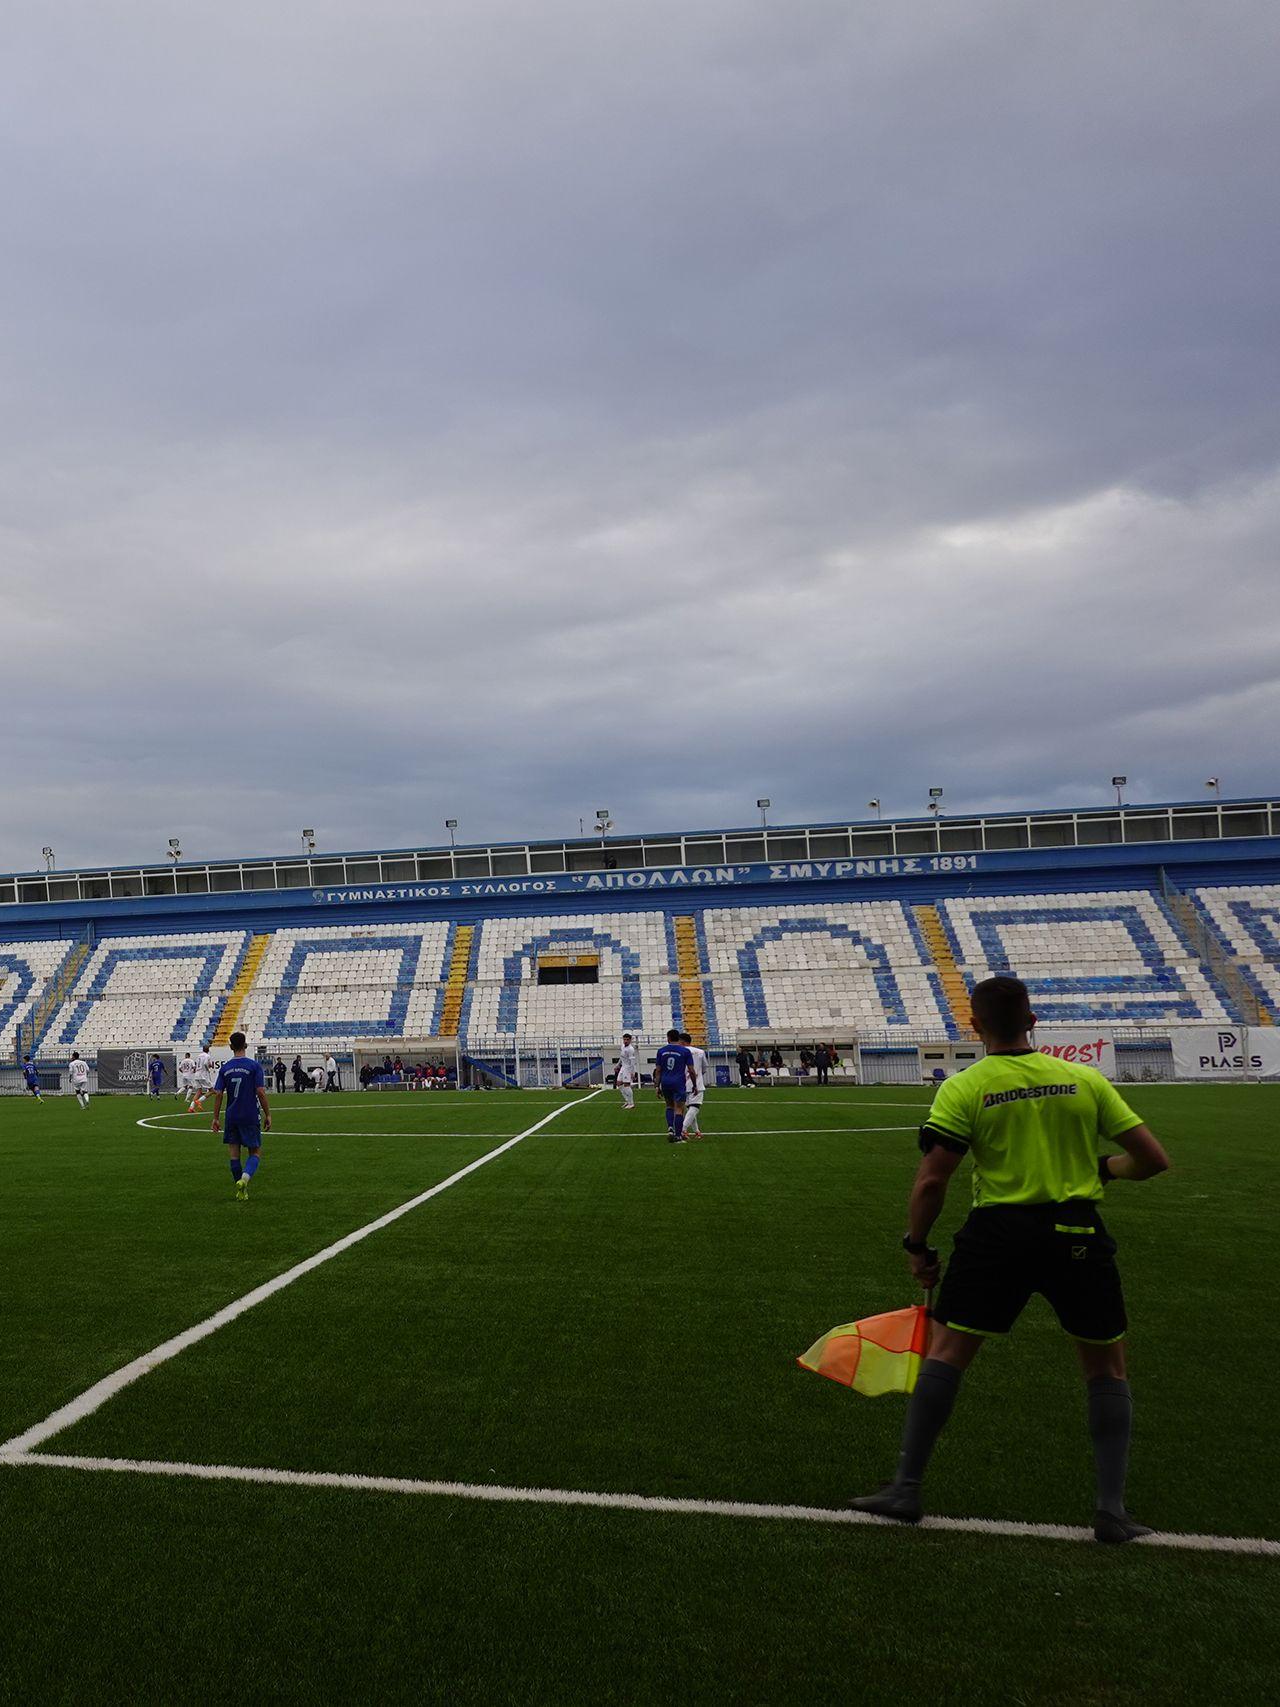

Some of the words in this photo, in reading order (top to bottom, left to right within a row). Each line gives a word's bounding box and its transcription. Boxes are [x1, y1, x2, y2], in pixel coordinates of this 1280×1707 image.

[327, 886, 450, 902] ΓΥΜΝΑΣΤΙΚΟΣ
[461, 881, 556, 895] ΣΥΛΛΟΓΟΣ
[769, 858, 921, 879] ΣΜΥΡΝΗΣ
[930, 855, 977, 871] 1891
[666, 1057, 675, 1071] 9
[1199, 1055, 1263, 1068] PLASS
[231, 1077, 242, 1098] 7
[983, 1083, 1077, 1108] BRIDGESTONE
